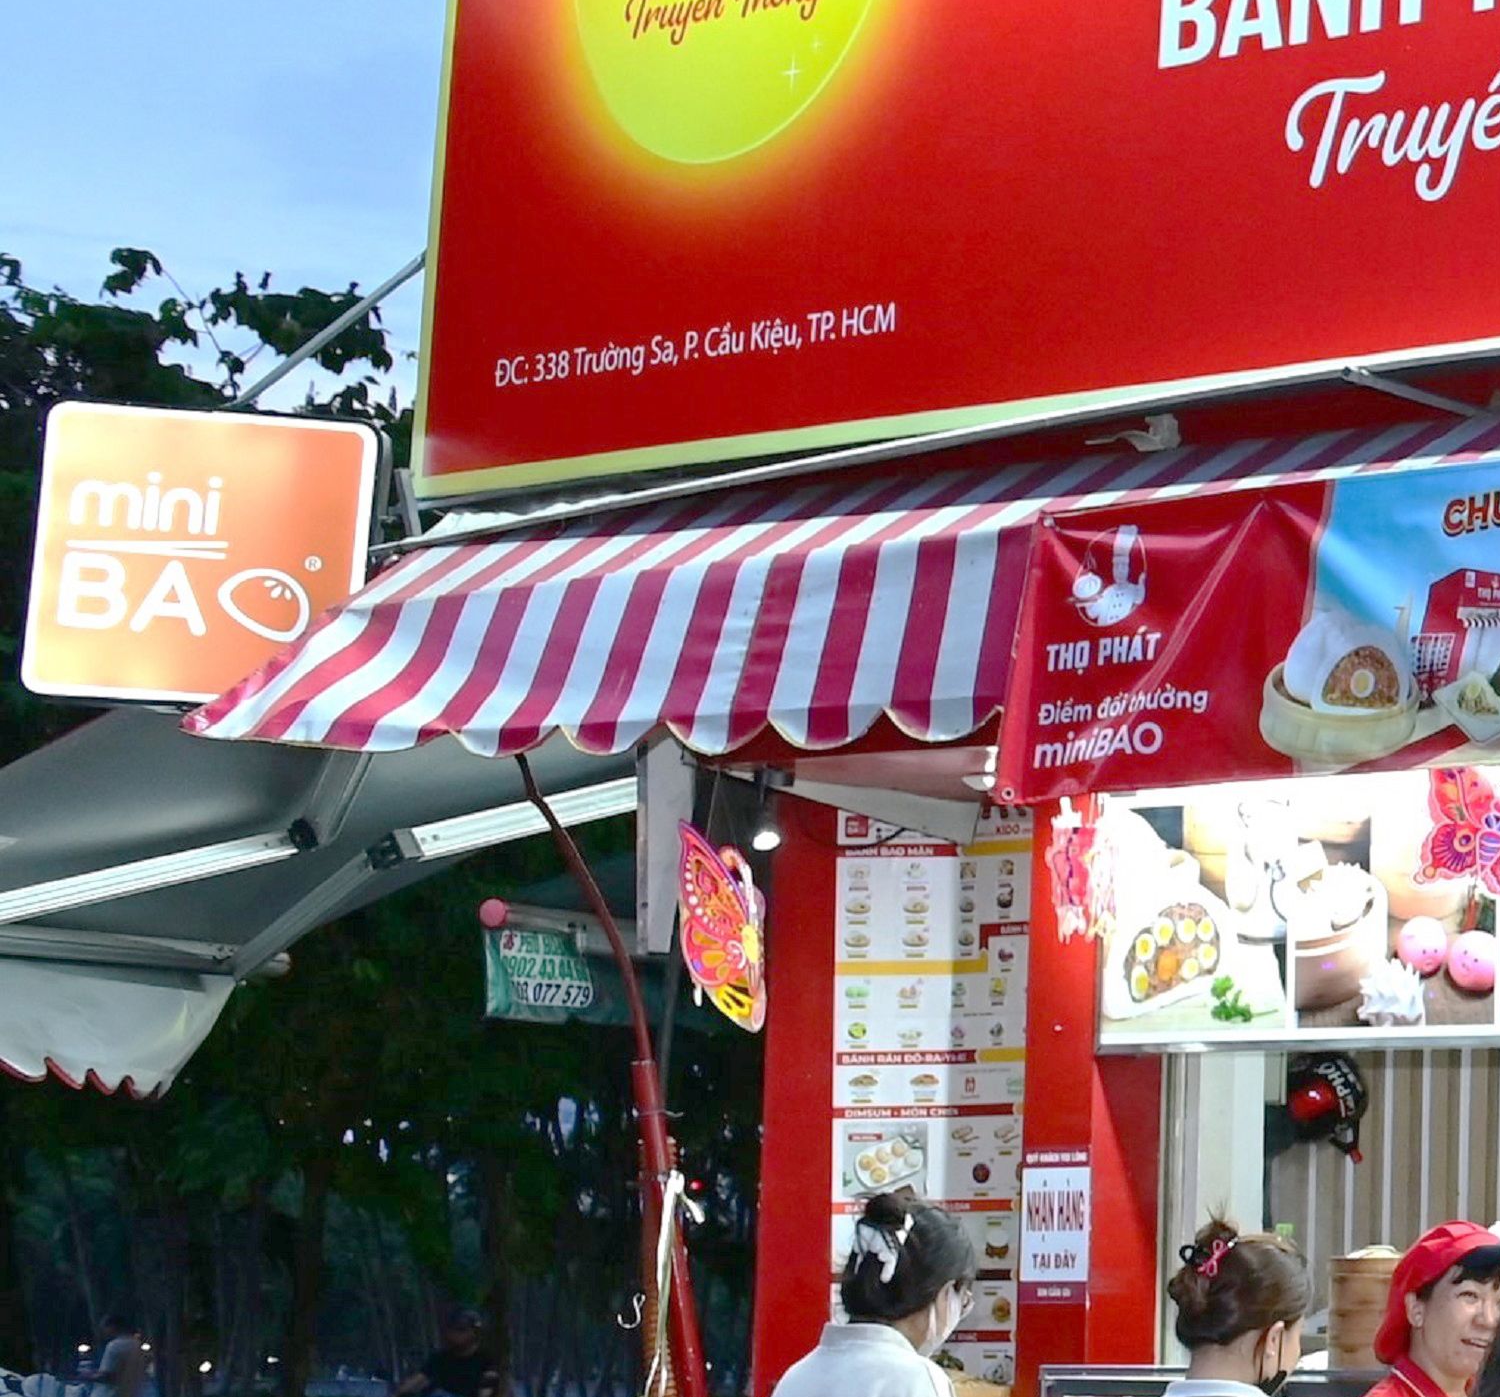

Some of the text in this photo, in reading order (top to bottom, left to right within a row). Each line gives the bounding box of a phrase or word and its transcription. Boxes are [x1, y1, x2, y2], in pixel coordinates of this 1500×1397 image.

[533, 350, 569, 382] 338
[574, 342, 645, 376] Trường
[650, 335, 679, 365] Sa,
[684, 330, 700, 359] P.
[704, 322, 745, 357] Cầu
[750, 317, 802, 356] Kiệu,
[807, 310, 836, 343] TP.
[842, 302, 897, 338] HCM
[68, 473, 223, 537] mini
[1046, 625, 1162, 674] THỌ PHÁT
[1033, 719, 1163, 770] miniBAO
[1032, 1249, 1077, 1273] TẠI ĐÂY
